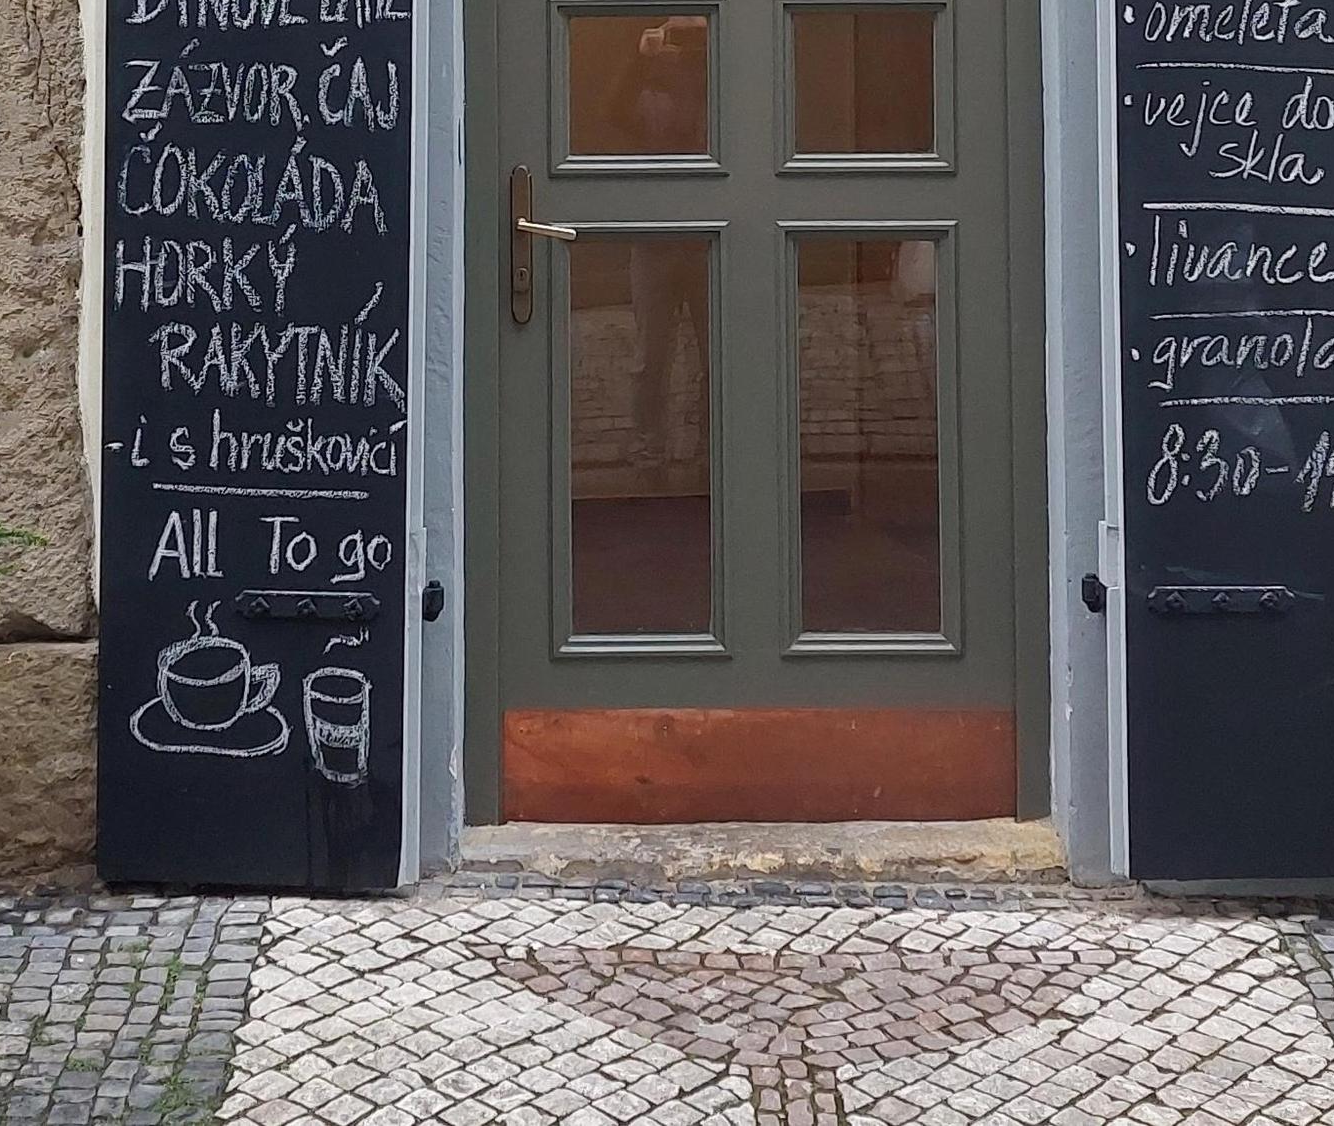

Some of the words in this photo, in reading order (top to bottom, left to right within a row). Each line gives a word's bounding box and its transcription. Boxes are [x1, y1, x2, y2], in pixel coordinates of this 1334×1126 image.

[317, 36, 400, 134] ČAJ
[1144, 80, 1257, 158] vejce
[1209, 129, 1325, 185] skla
[114, 223, 298, 317] HORKÝ
[259, 516, 318, 575] To
[329, 528, 393, 585] go
